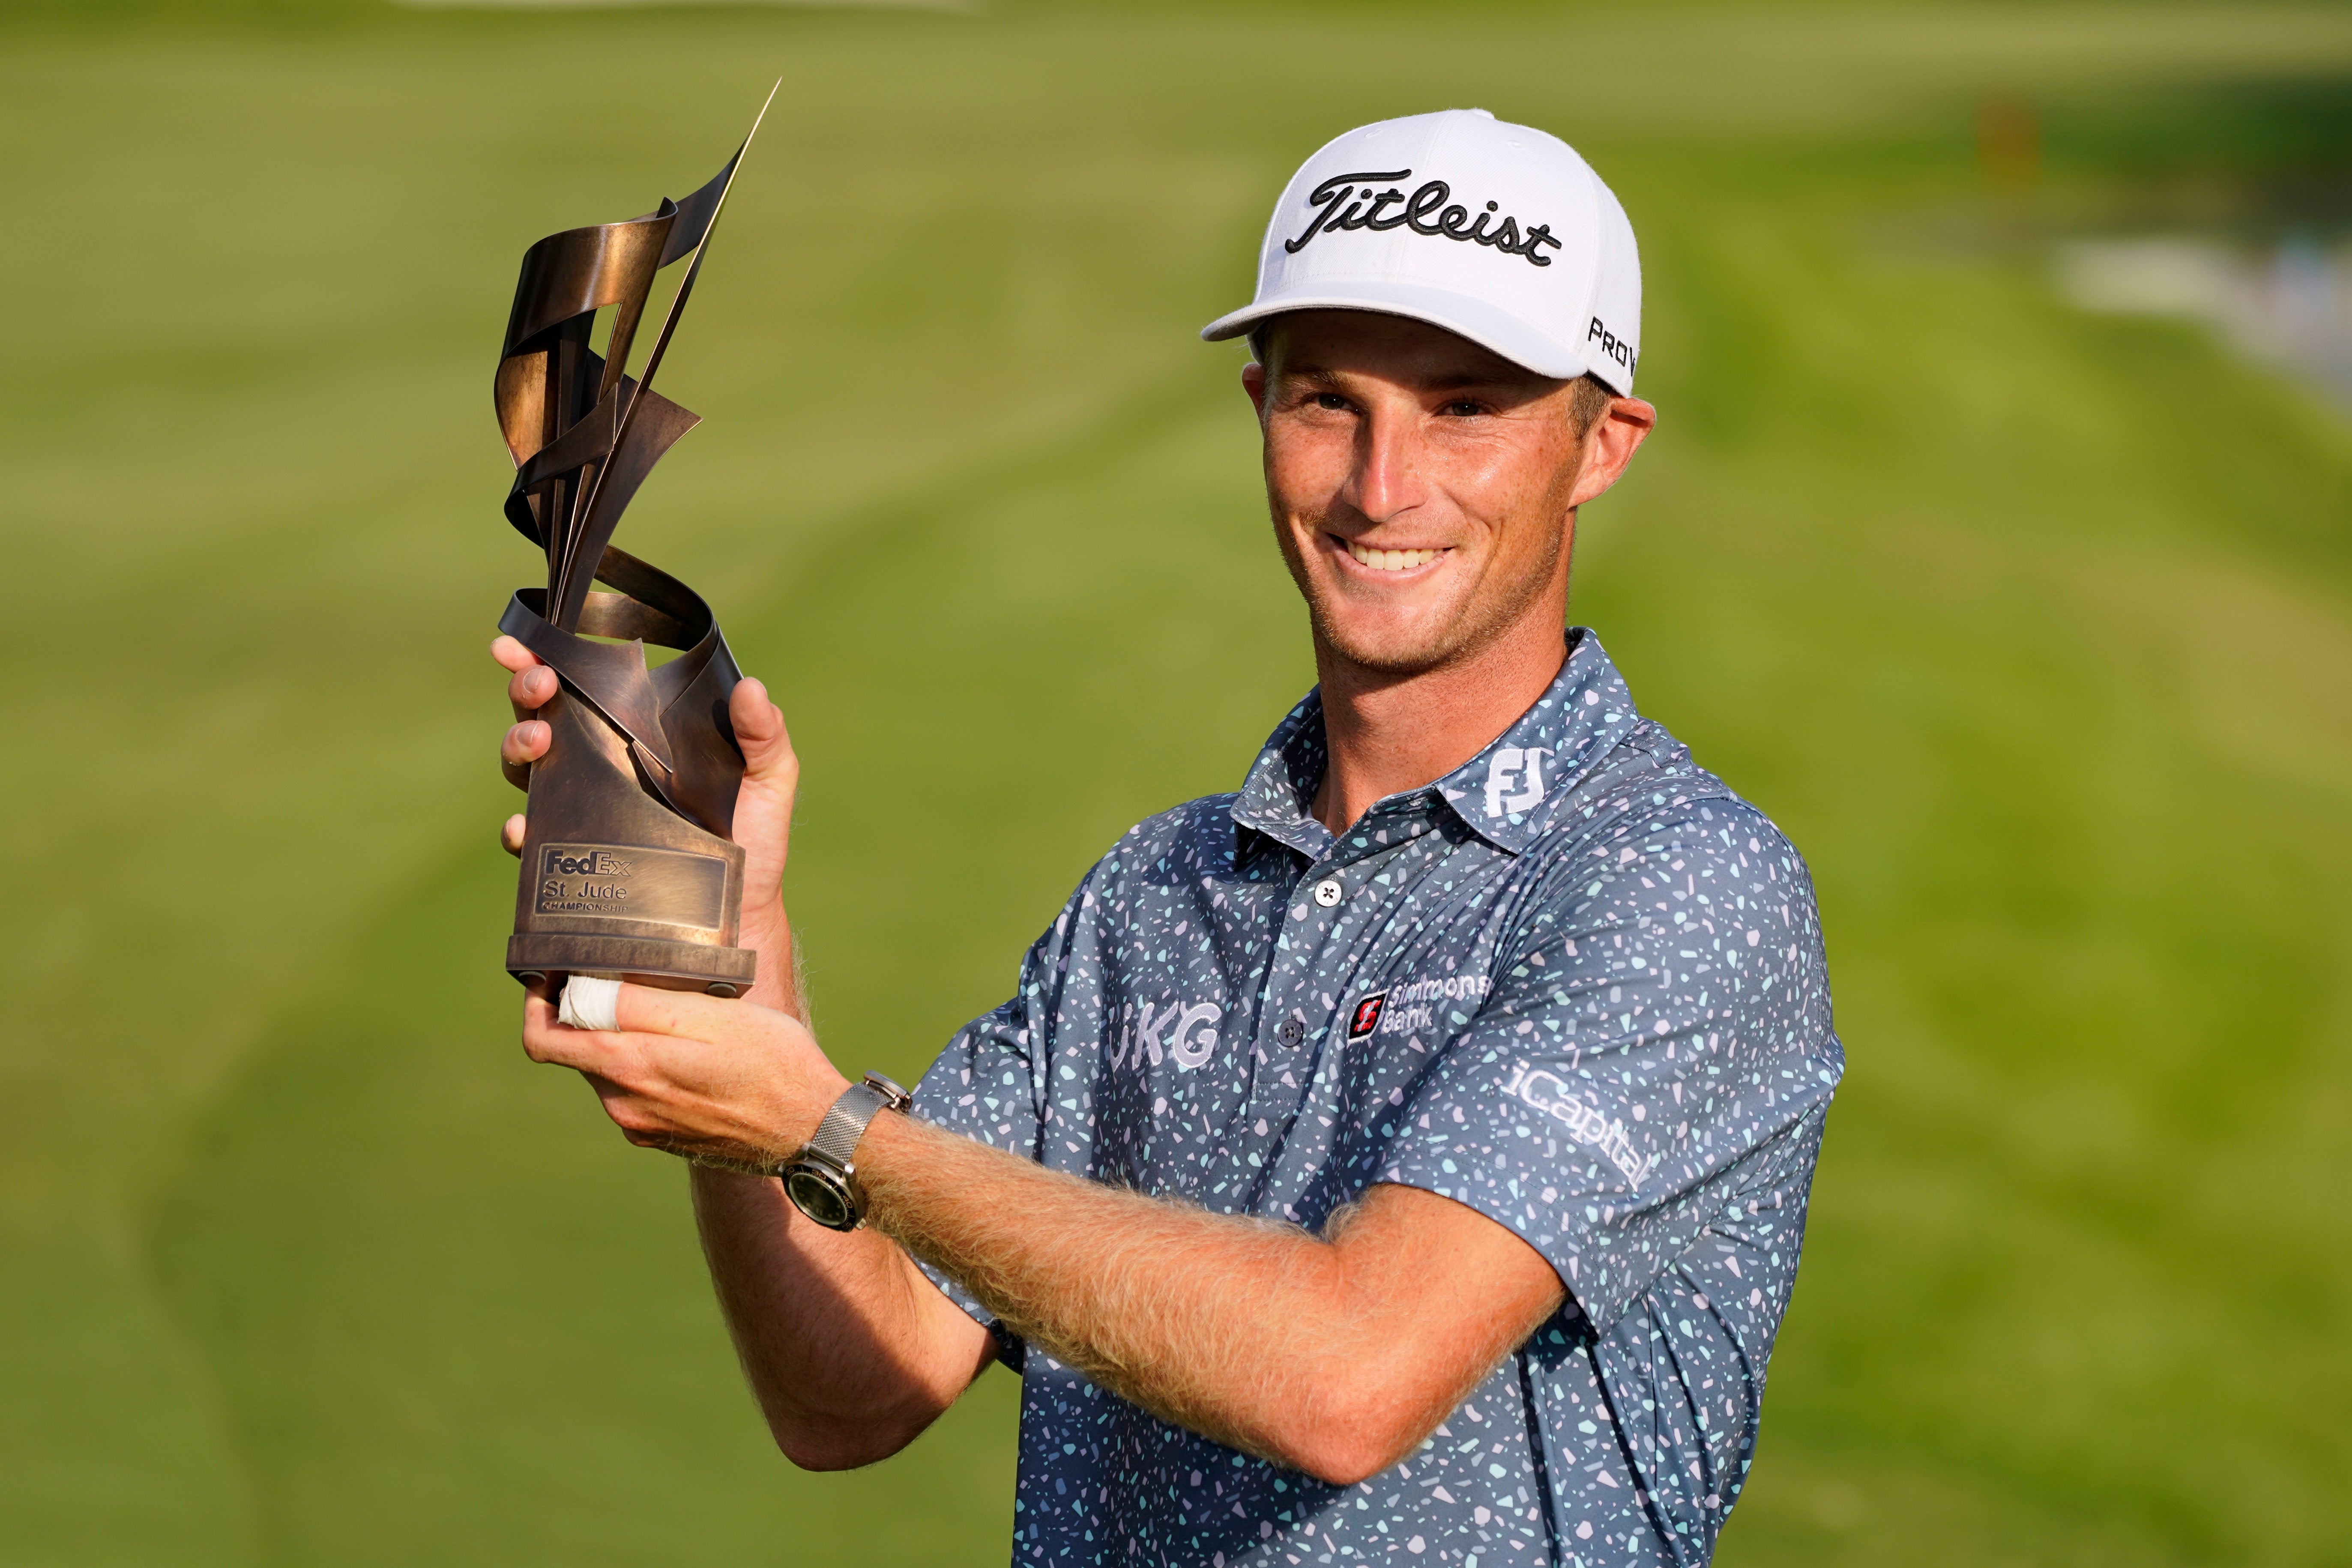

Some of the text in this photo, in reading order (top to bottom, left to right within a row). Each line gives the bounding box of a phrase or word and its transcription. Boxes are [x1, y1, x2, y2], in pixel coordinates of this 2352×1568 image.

[1285, 169, 1562, 266] Titleist
[1487, 747, 1544, 818] FJ
[545, 850, 632, 877] FedEx
[543, 880, 626, 899] St. Jude
[542, 901, 628, 913] CHAMPIONSHIP
[1503, 1060, 1652, 1192] iCapital
[812, 1169, 826, 1180] 30
[842, 1195, 853, 1209] 40
